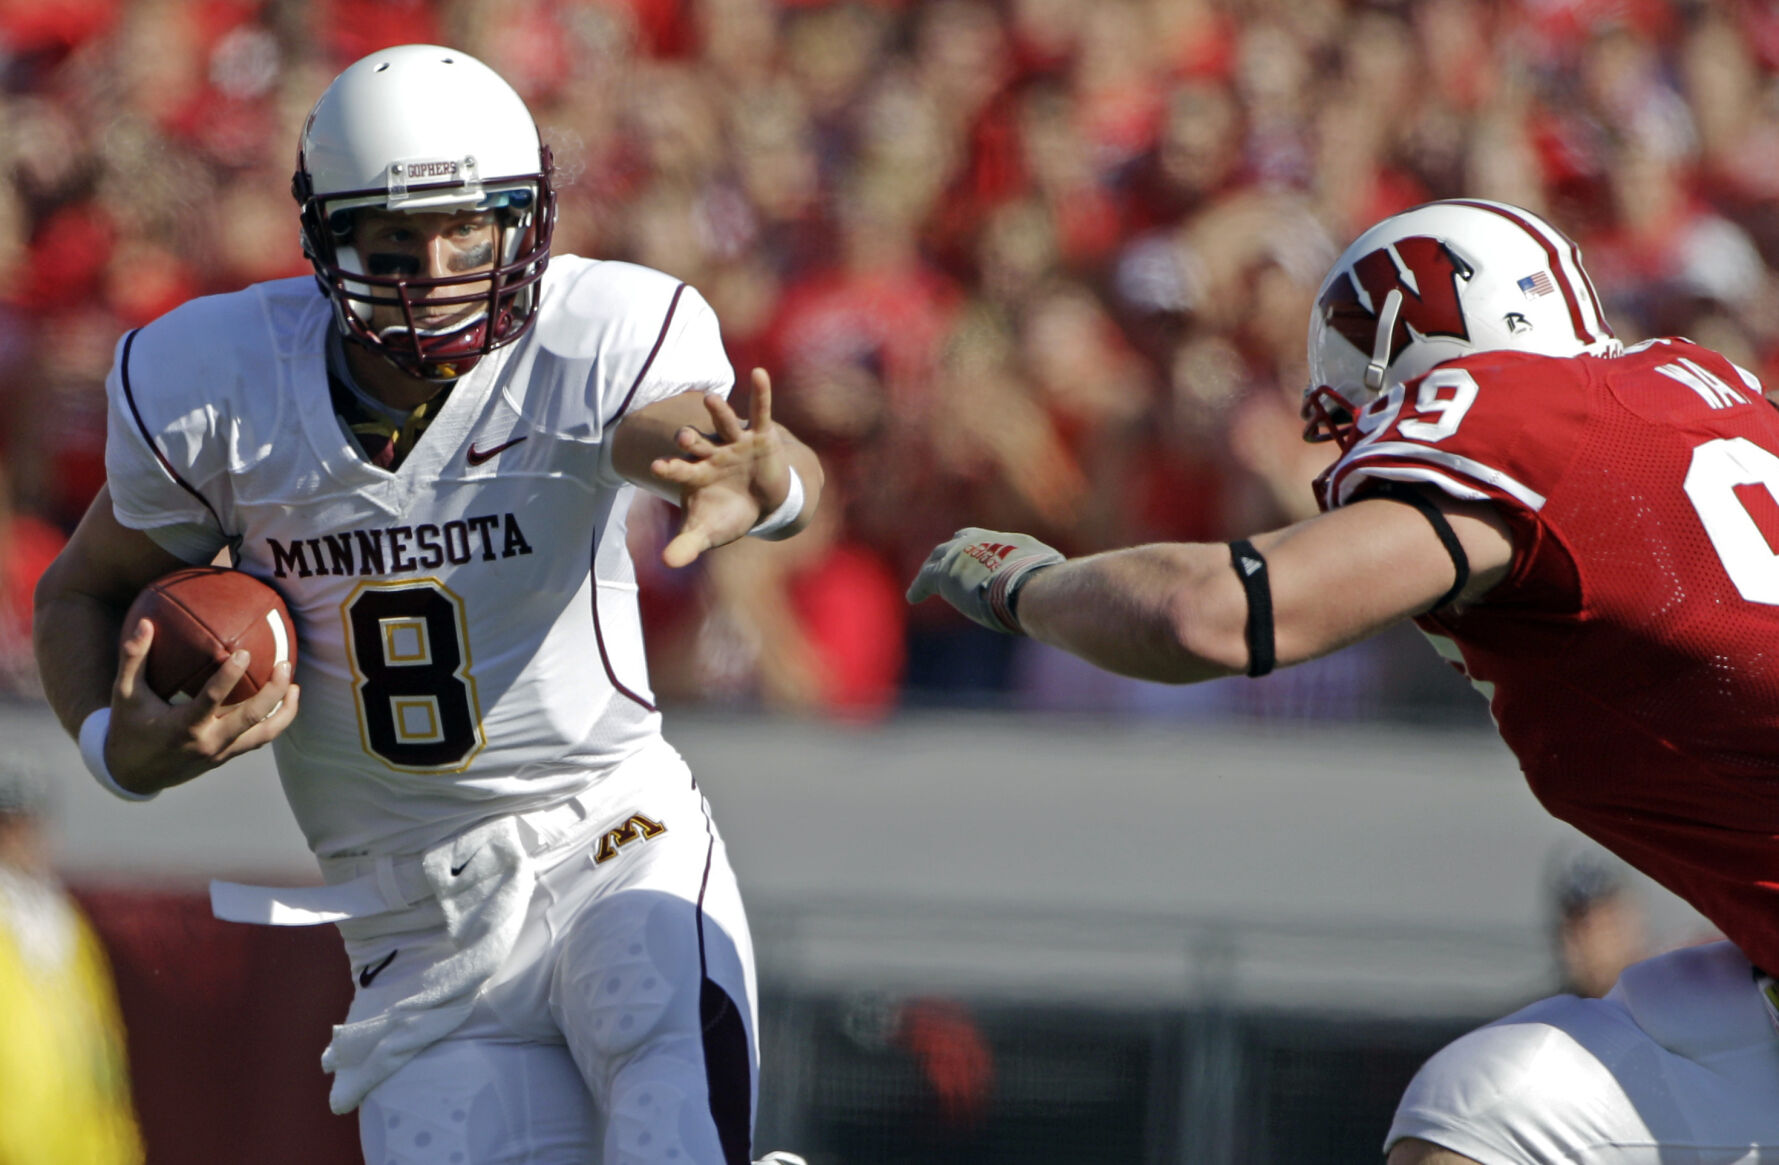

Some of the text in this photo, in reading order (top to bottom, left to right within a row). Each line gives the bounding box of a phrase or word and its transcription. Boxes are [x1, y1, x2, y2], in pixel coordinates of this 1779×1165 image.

[407, 162, 457, 177] GOPHERS
[1318, 235, 1471, 368] W
[1350, 368, 1480, 443] 99
[266, 513, 533, 578] MINNESOTA
[340, 576, 487, 775] 8
[594, 811, 668, 864] M
